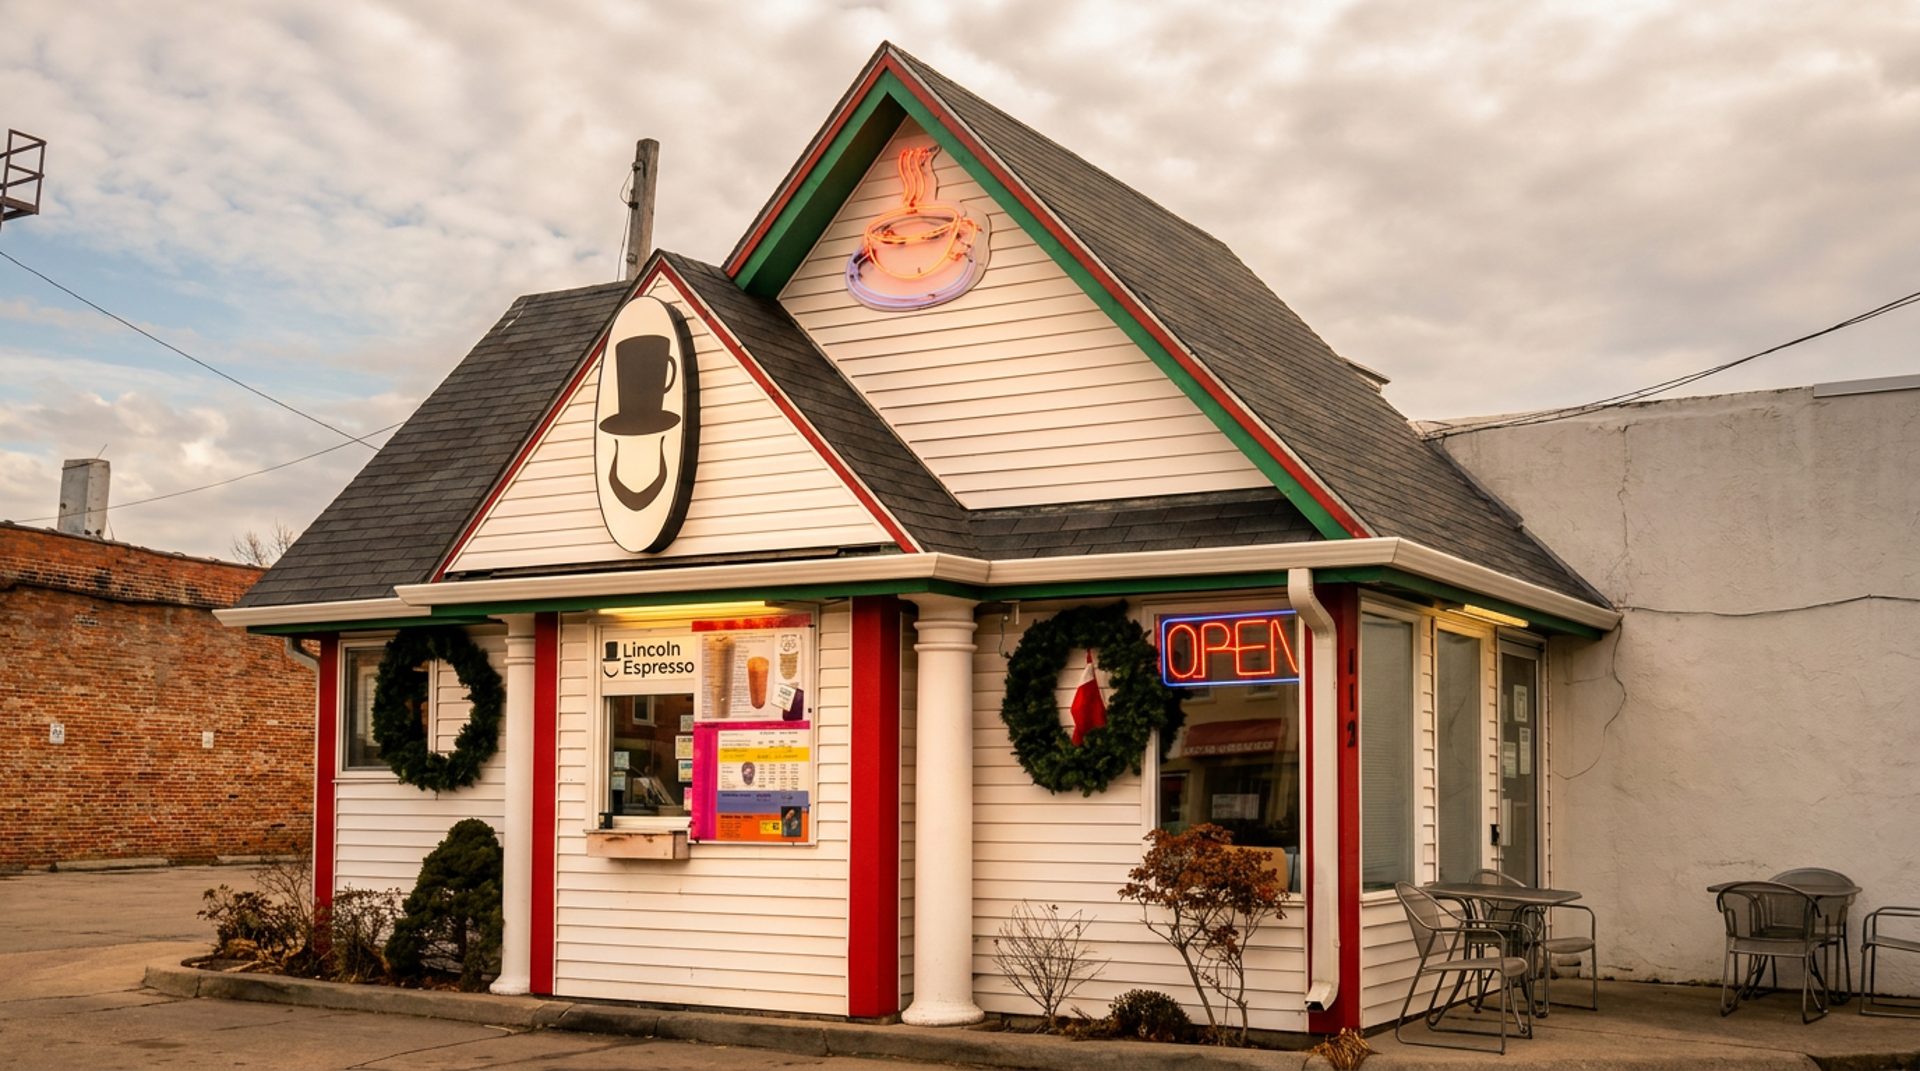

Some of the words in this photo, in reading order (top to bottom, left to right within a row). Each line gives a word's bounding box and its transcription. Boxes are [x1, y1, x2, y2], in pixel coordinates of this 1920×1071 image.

[623, 641, 681, 659] Lincoln
[1167, 619, 1299, 679] OPEN
[623, 659, 695, 678] Espresso
